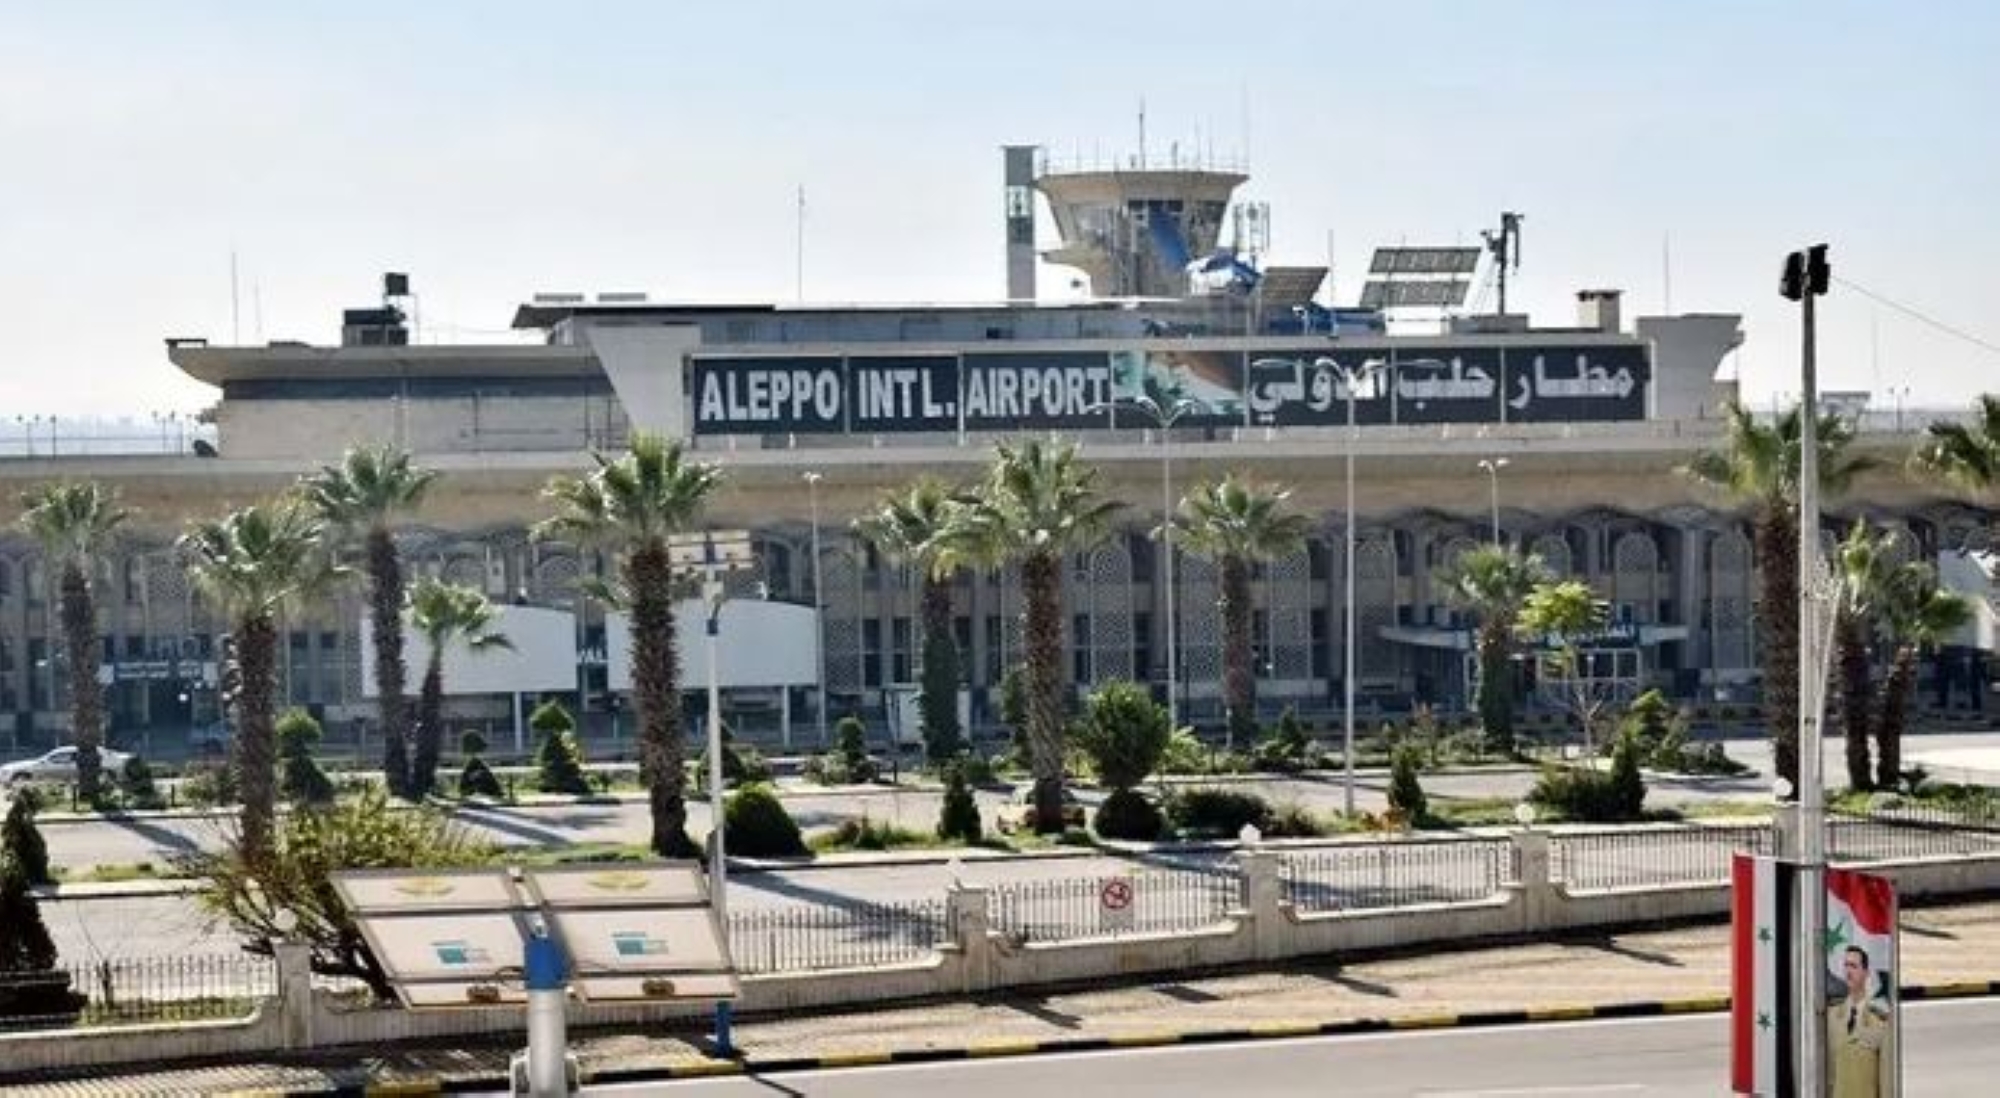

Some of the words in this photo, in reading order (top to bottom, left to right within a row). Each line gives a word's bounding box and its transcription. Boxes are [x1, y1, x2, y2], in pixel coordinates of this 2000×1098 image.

[700, 369, 840, 420] ALEPPO
[858, 369, 955, 418] INTL.
[966, 367, 1109, 415] AIRPORT
[1400, 356, 1495, 410] حلب
[1508, 355, 1634, 409] مطار
